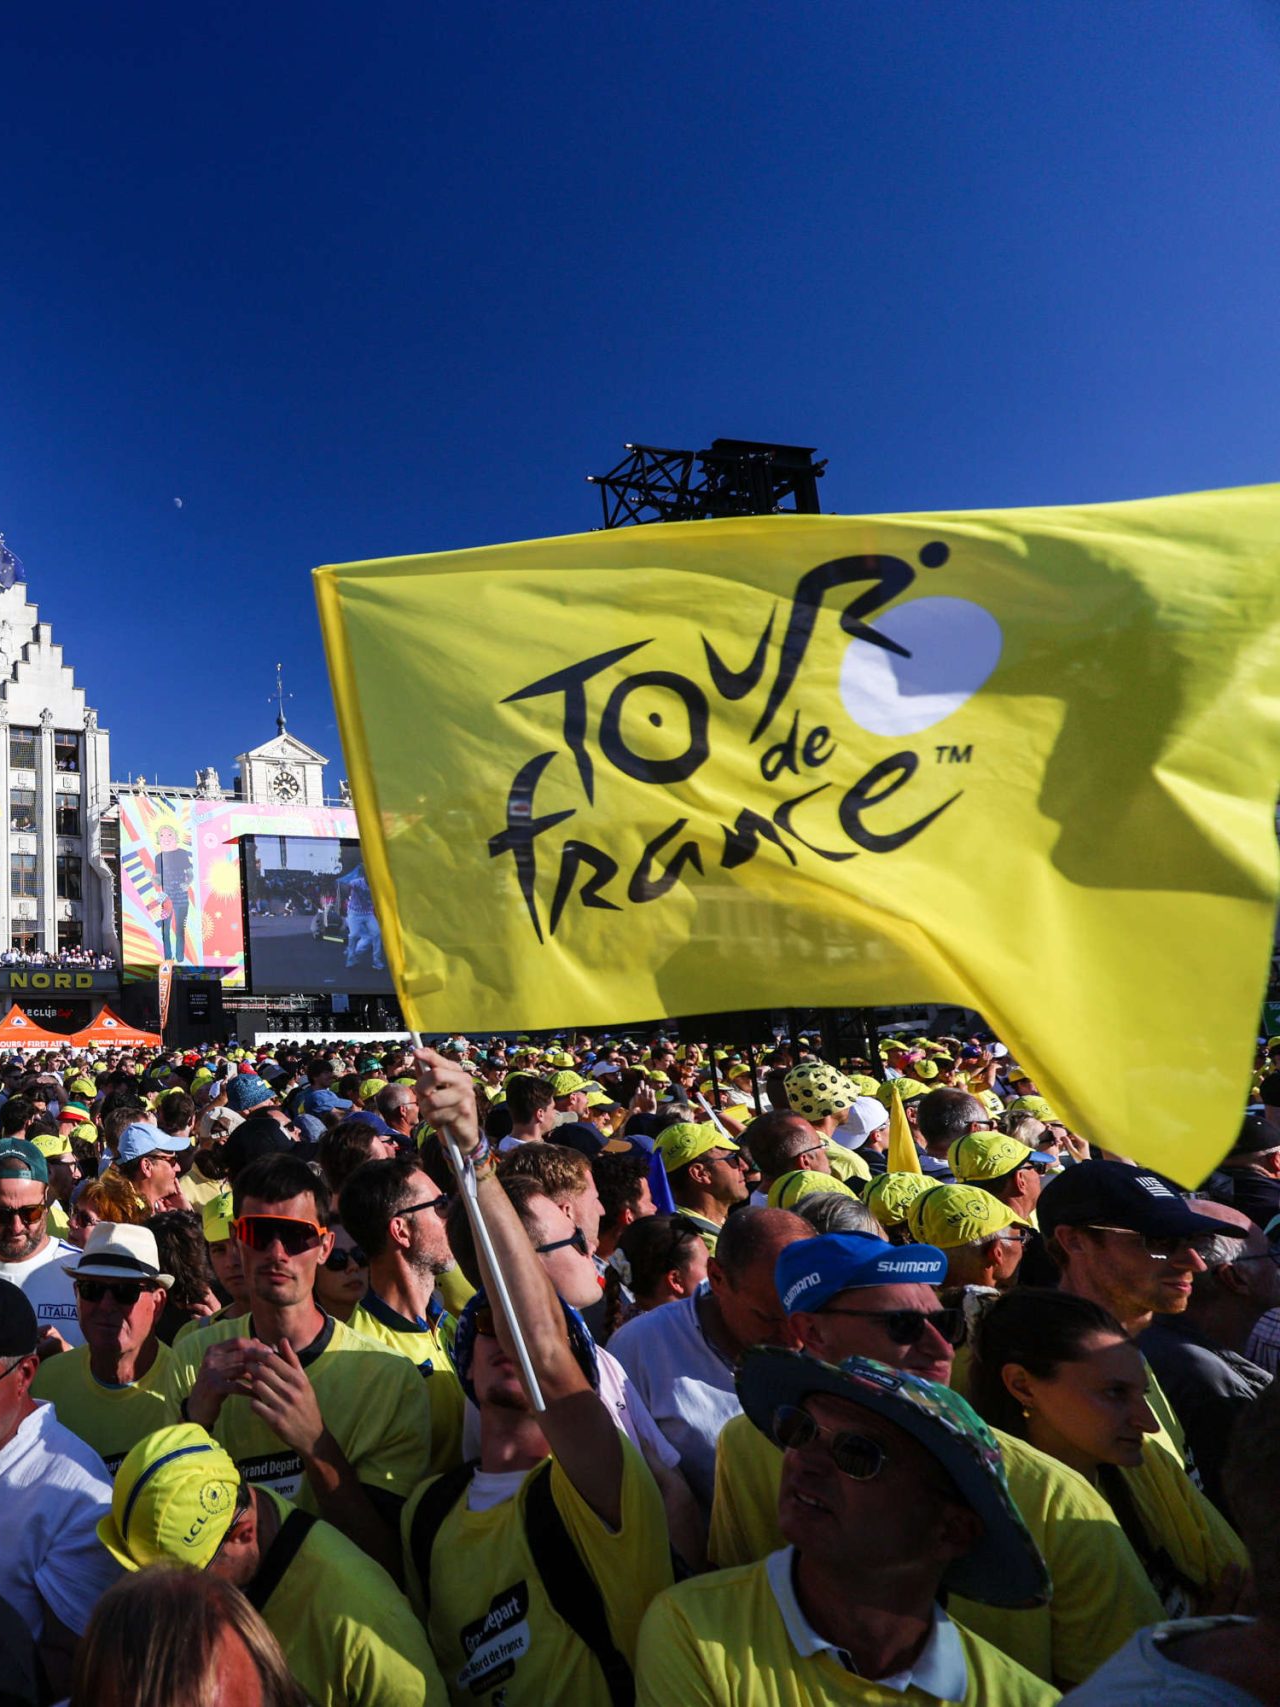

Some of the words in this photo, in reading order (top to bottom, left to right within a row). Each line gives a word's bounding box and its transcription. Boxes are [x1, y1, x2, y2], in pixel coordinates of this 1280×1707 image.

[761, 709, 837, 782] de
[934, 744, 974, 765] TM
[9, 972, 94, 989] NORD
[947, 1212, 967, 1224] LCL
[877, 1260, 941, 1273] SHIMANO
[183, 1514, 209, 1544] LCL
